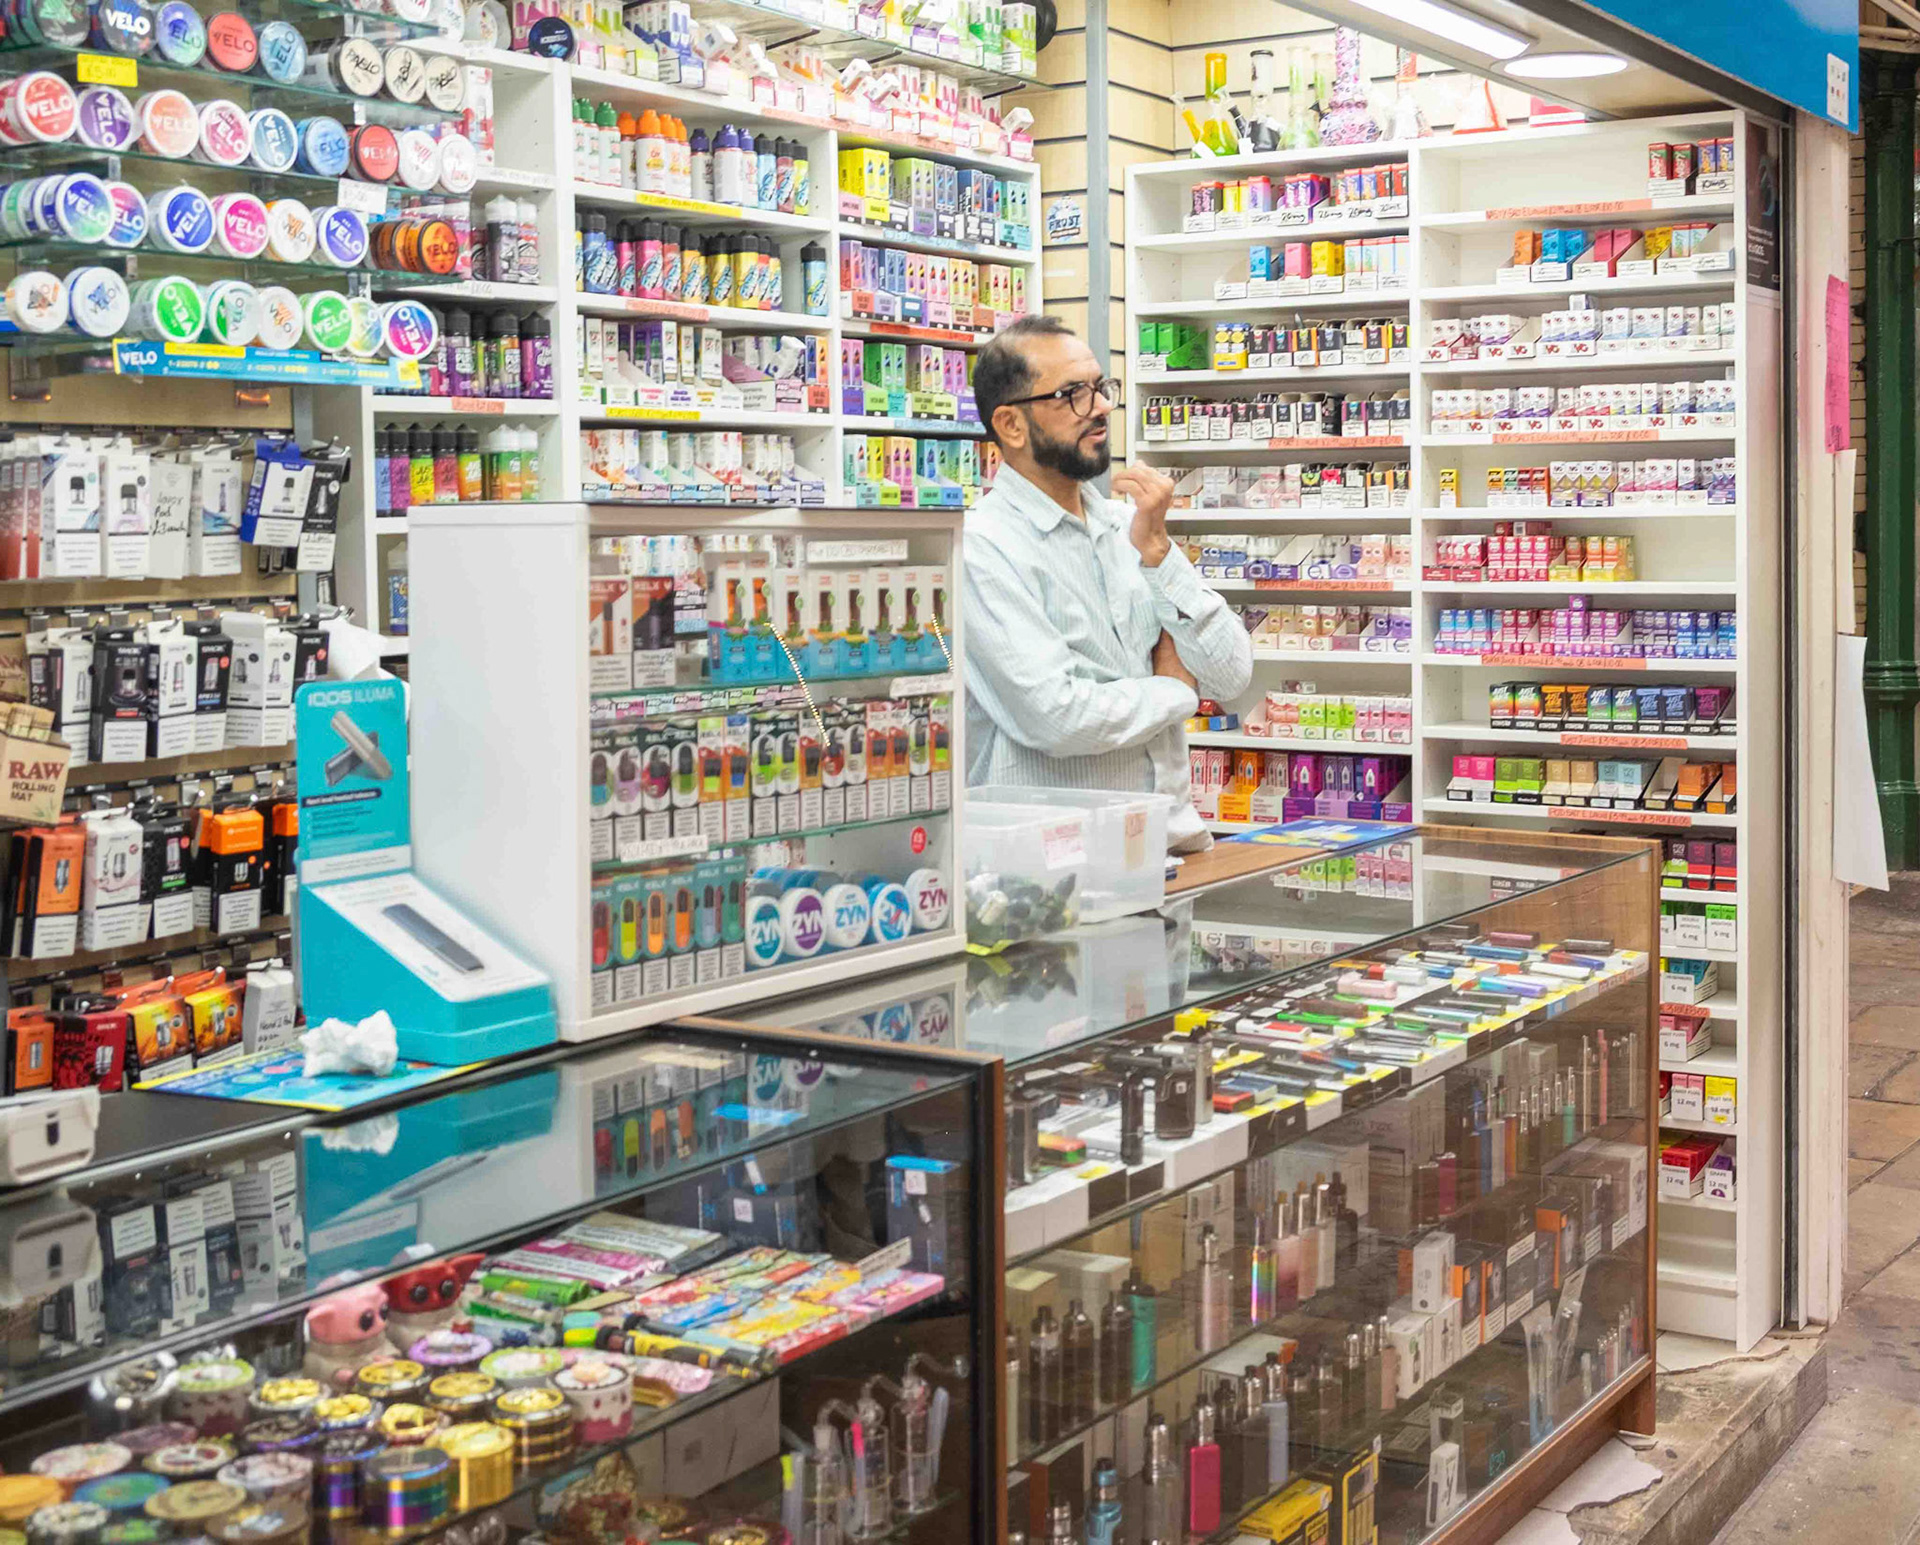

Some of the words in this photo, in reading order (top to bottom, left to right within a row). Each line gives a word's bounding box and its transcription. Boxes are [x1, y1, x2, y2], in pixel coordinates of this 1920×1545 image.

[106, 9, 151, 35] VELO
[212, 32, 255, 53] VELO
[273, 30, 296, 71] VELO
[346, 49, 380, 75] PABLO
[25, 94, 73, 118] VELO
[95, 93, 118, 148] VELO
[152, 116, 193, 131] VELO
[212, 111, 246, 153] VELO
[262, 116, 286, 166] VELO
[66, 190, 109, 226] VELO
[114, 208, 145, 231] ELO
[173, 199, 207, 240] VELO
[226, 213, 267, 239] VELO
[329, 216, 363, 255] VELO
[163, 285, 194, 336] VELO
[312, 308, 352, 336] VELO
[398, 306, 424, 354] VELO
[120, 350, 158, 365] VELO
[307, 690, 353, 707] IQOS
[354, 686, 396, 703] ILUMA
[8, 760, 65, 780] RAW
[11, 781, 56, 794] ROLLING
[11, 791, 35, 802] MAT
[919, 890, 947, 908] ZYN
[752, 917, 782, 938] ZYN
[792, 913, 822, 936] ZYN
[835, 907, 867, 926] ZYN
[1674, 1178, 1684, 1186] mg
[1717, 1182, 1728, 1190] mg
